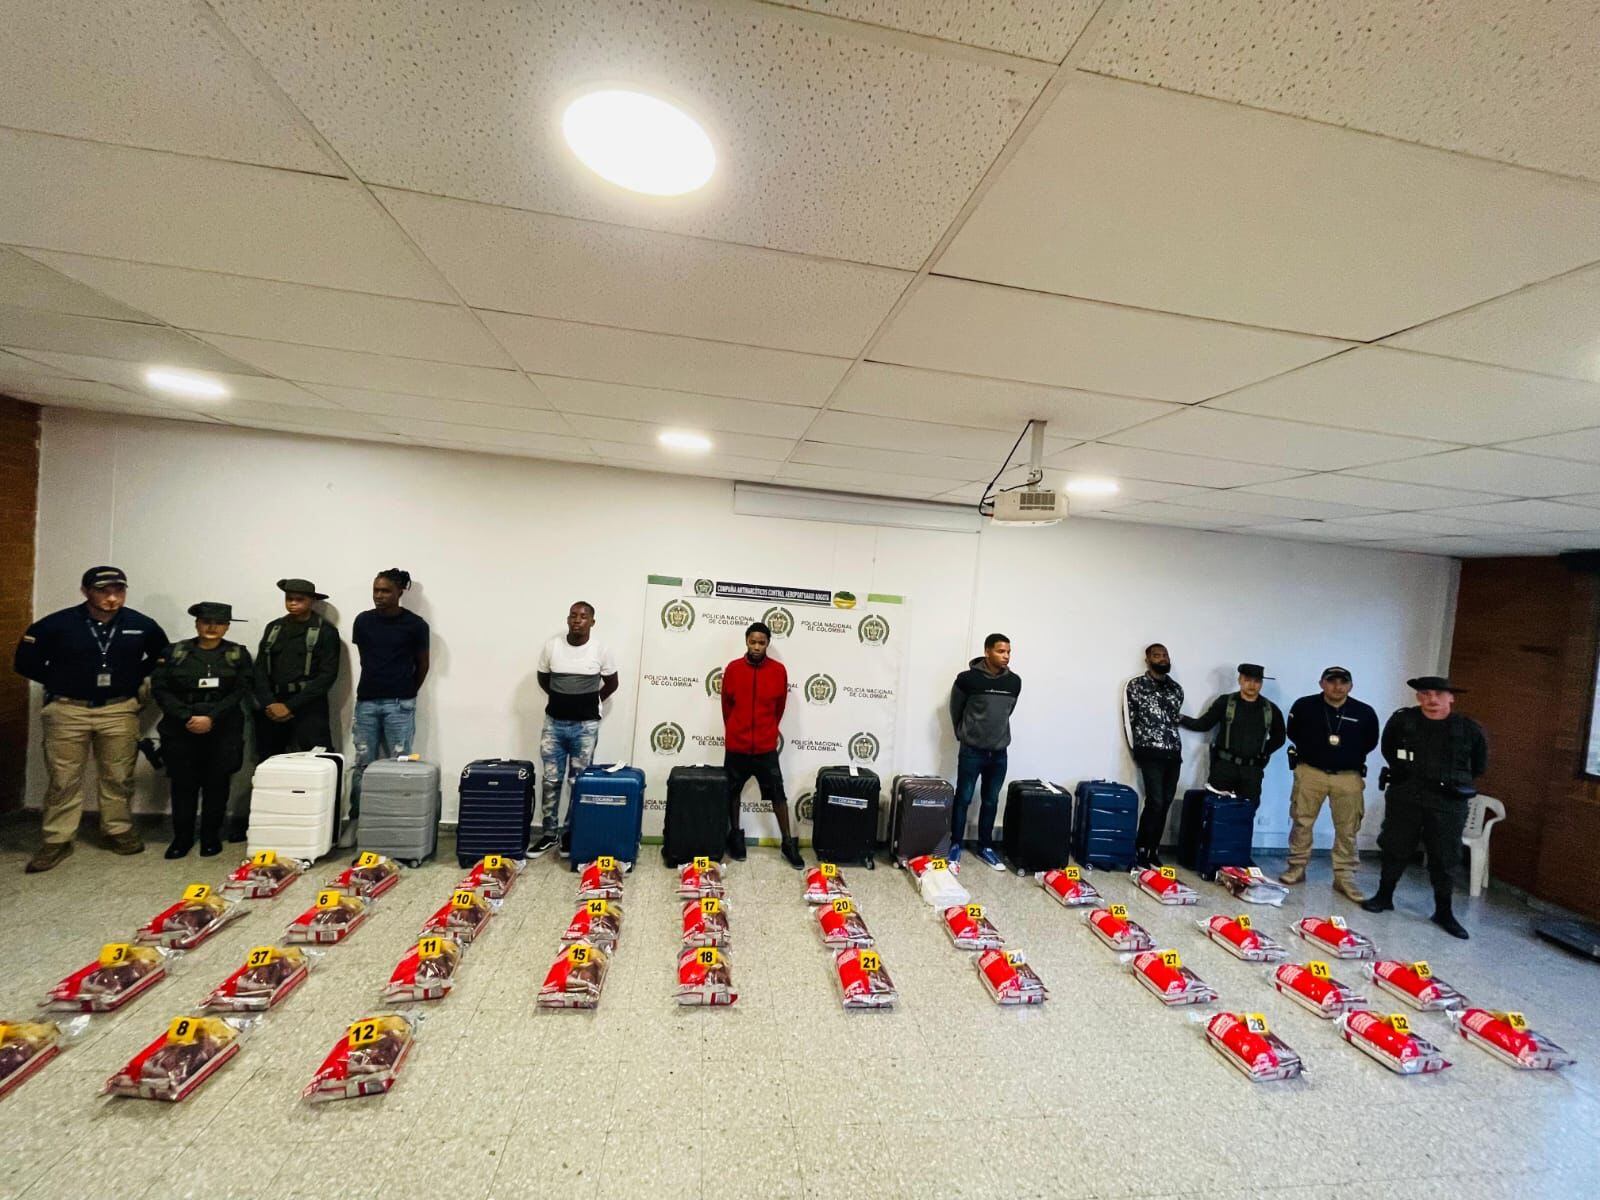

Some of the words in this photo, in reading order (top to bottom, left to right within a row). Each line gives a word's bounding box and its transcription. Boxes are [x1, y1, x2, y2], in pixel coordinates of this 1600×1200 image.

[260, 854, 266, 863] 1
[365, 856, 373, 864] 5
[491, 858, 498, 866] 9
[600, 858, 610, 867] 13
[696, 859, 706, 867] 16
[824, 865, 834, 873] 19
[932, 861, 944, 869] 22
[1068, 869, 1078, 877] 25
[1163, 868, 1174, 877] 29
[194, 887, 205, 897] 2
[320, 894, 328, 905] 6
[456, 894, 469, 904] 10
[590, 902, 602, 912] 14
[704, 901, 715, 910] 17
[836, 901, 848, 911] 20
[1113, 906, 1125, 915] 26
[969, 908, 980, 917] 23
[423, 940, 436, 952] 11
[113, 948, 123, 960] 3
[251, 950, 270, 964] 37
[572, 948, 586, 960] 15
[700, 951, 712, 963] 18
[1165, 954, 1176, 964] 27
[863, 957, 875, 968] 21
[1313, 964, 1326, 976] 31
[1417, 964, 1430, 975] 35
[1250, 1018, 1265, 1031] 28
[1394, 1016, 1408, 1029] 32
[1511, 1014, 1524, 1026] 36
[176, 1021, 189, 1035] 8
[353, 1024, 374, 1041] 12
